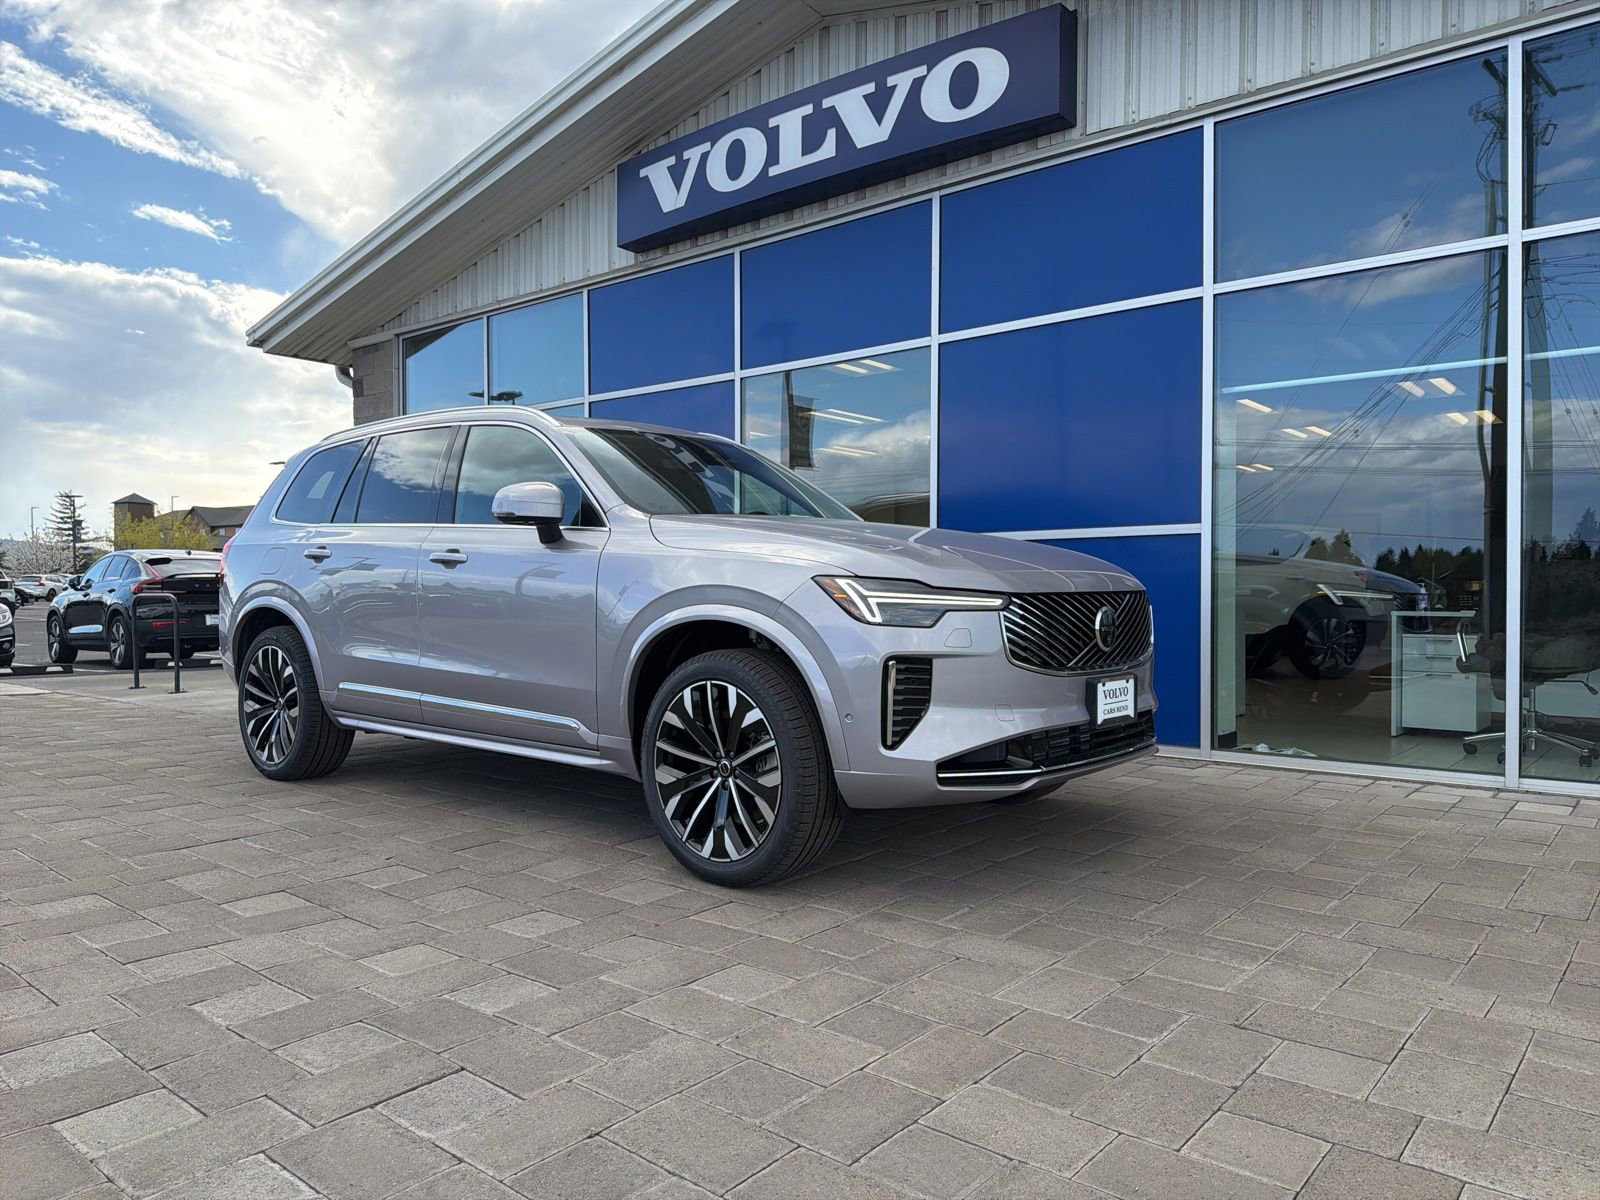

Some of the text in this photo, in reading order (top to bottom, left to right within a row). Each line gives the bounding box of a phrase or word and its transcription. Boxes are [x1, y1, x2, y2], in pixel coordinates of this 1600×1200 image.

[639, 47, 1010, 213] VOLVO
[1103, 686, 1129, 700] VOLVO
[1103, 707, 1116, 715] CARS
